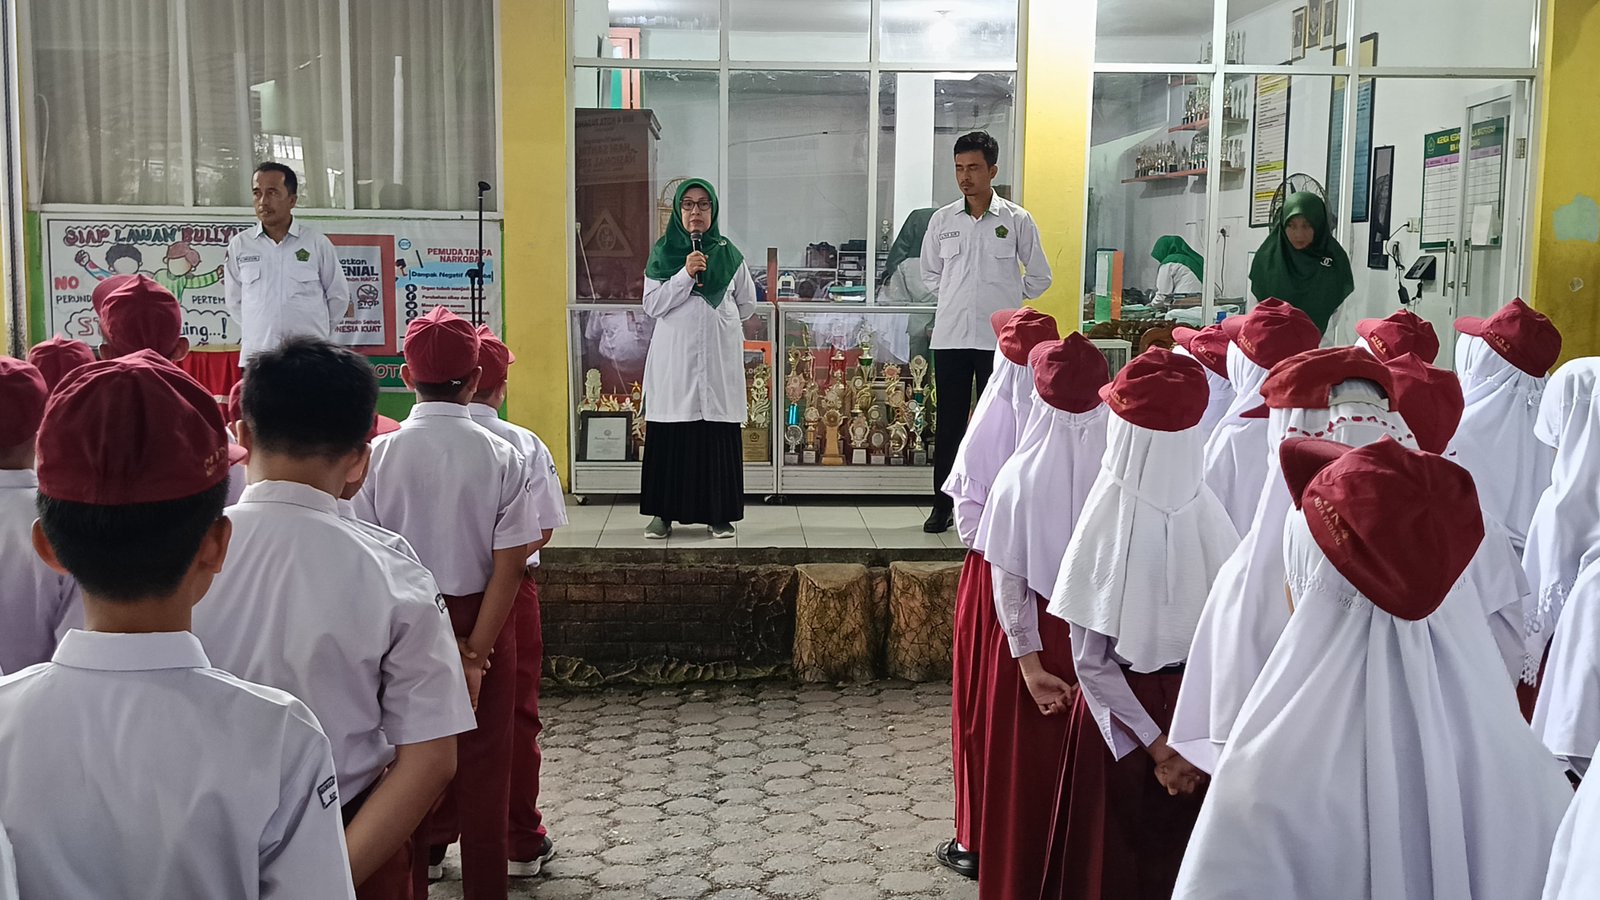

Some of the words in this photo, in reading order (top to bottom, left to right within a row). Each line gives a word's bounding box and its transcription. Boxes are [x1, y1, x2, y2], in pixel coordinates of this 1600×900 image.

[66, 229, 110, 245] SIAP
[115, 227, 177, 242] LAWAN
[427, 247, 463, 256] PEMUDA
[411, 271, 438, 279] Dampak
[54, 275, 79, 291] NO
[56, 294, 92, 304] PERUND
[191, 295, 226, 304] PERTEM
[360, 325, 382, 333] KUAT
